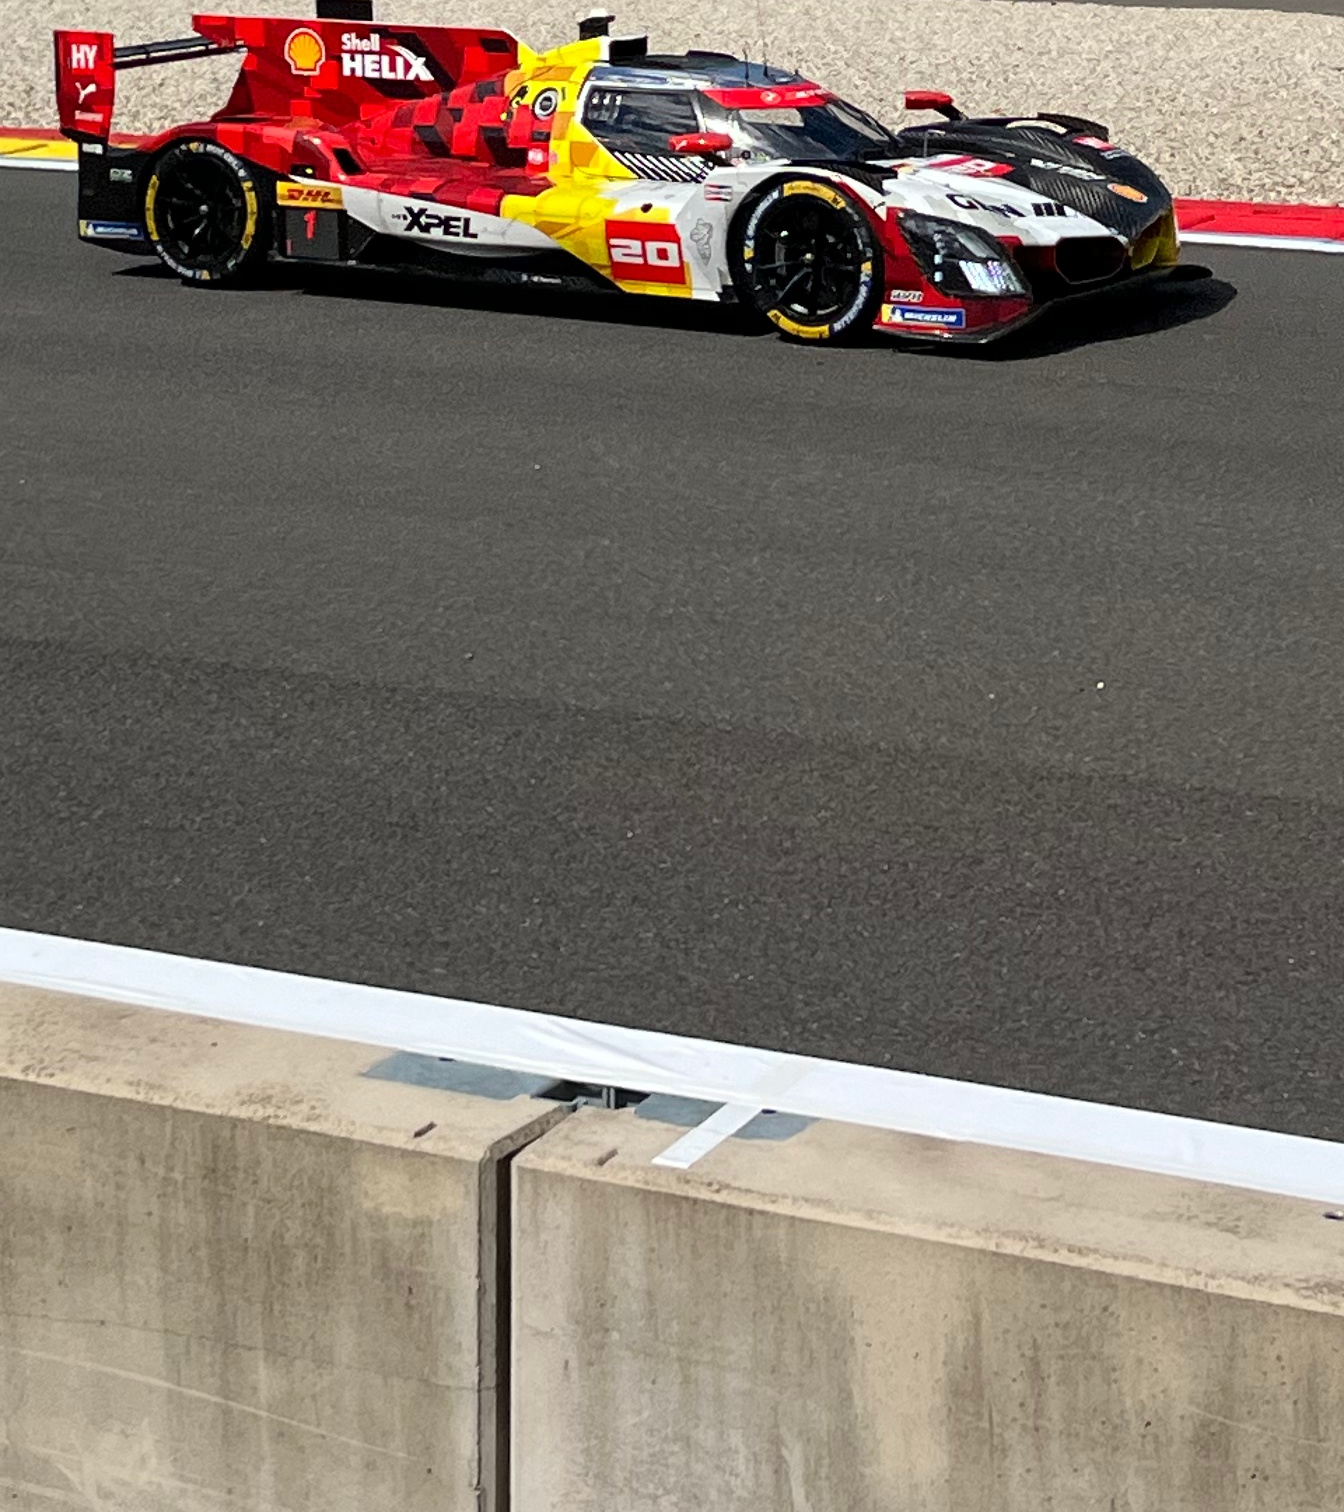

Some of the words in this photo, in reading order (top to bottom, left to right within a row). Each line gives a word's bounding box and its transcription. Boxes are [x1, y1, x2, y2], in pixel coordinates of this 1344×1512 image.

[341, 33, 380, 51] Shell
[71, 44, 97, 69] HY
[341, 45, 434, 81] HELIX
[287, 189, 335, 203] DHL
[403, 206, 479, 239] XPEL
[609, 238, 681, 268] 20
